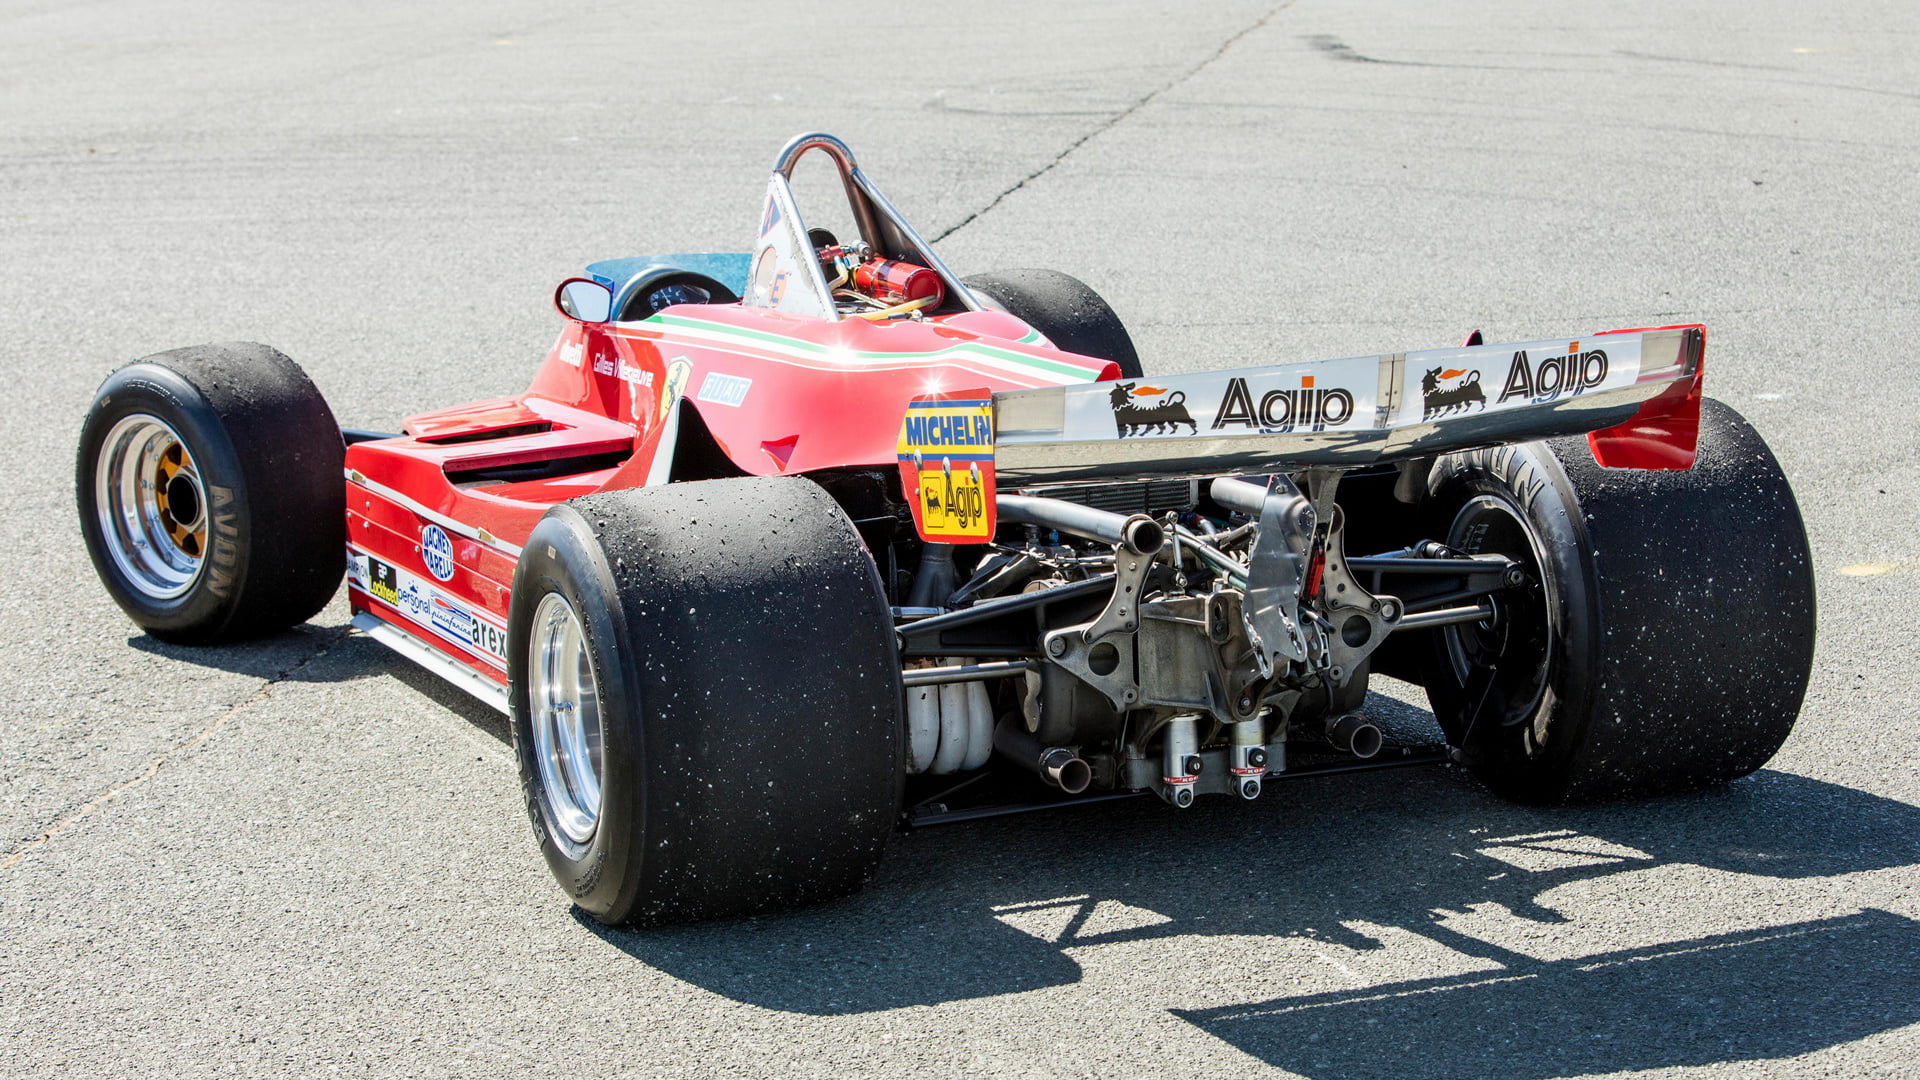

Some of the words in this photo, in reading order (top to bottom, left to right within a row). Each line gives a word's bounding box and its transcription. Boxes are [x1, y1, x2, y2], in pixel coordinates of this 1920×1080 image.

[700, 374, 749, 404] FIAT
[1496, 341, 1609, 404] Agip
[1210, 376, 1354, 434] Agip
[905, 415, 993, 446] MICHELIN
[945, 476, 983, 529] Agip
[206, 485, 239, 598] AVON
[422, 525, 452, 561] MAGNETI
[423, 548, 454, 581] MARELLI
[369, 575, 398, 606] Lockheed
[398, 588, 431, 616] personal
[431, 610, 472, 636] pininfarina
